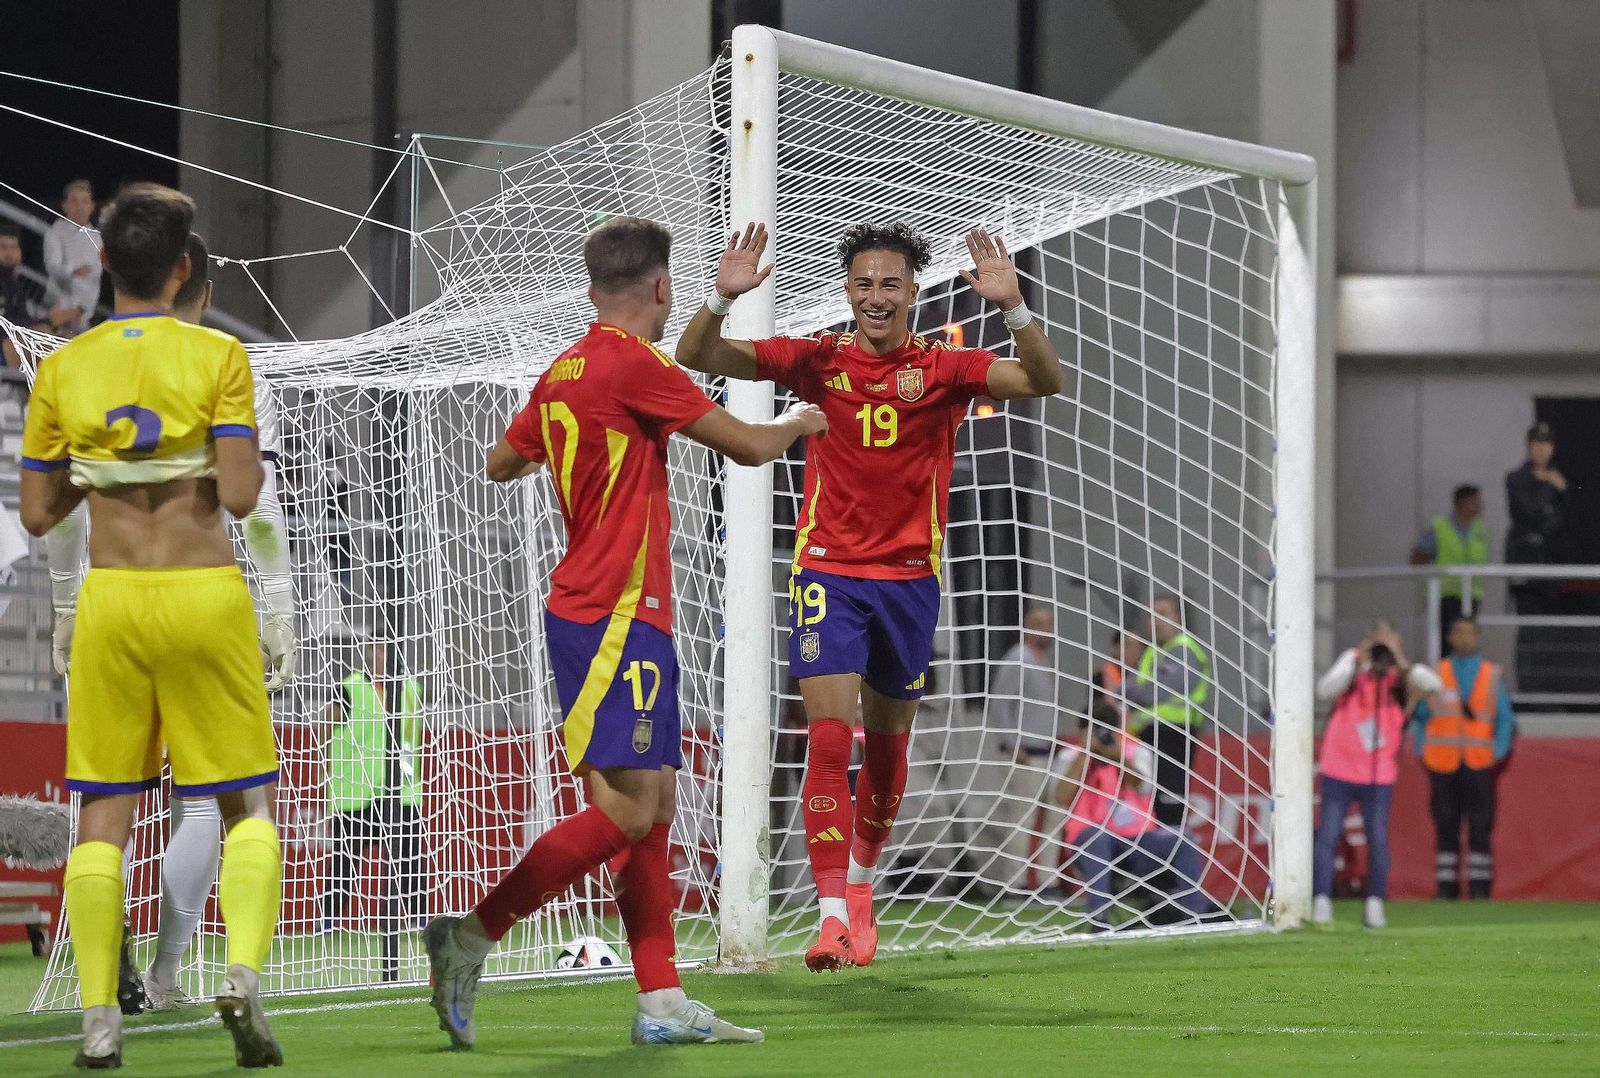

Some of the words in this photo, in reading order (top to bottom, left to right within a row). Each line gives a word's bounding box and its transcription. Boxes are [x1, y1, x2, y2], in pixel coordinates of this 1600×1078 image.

[855, 403, 898, 447] 19
[540, 401, 580, 519] 17
[795, 582, 827, 628] 19
[622, 660, 661, 711] 17
